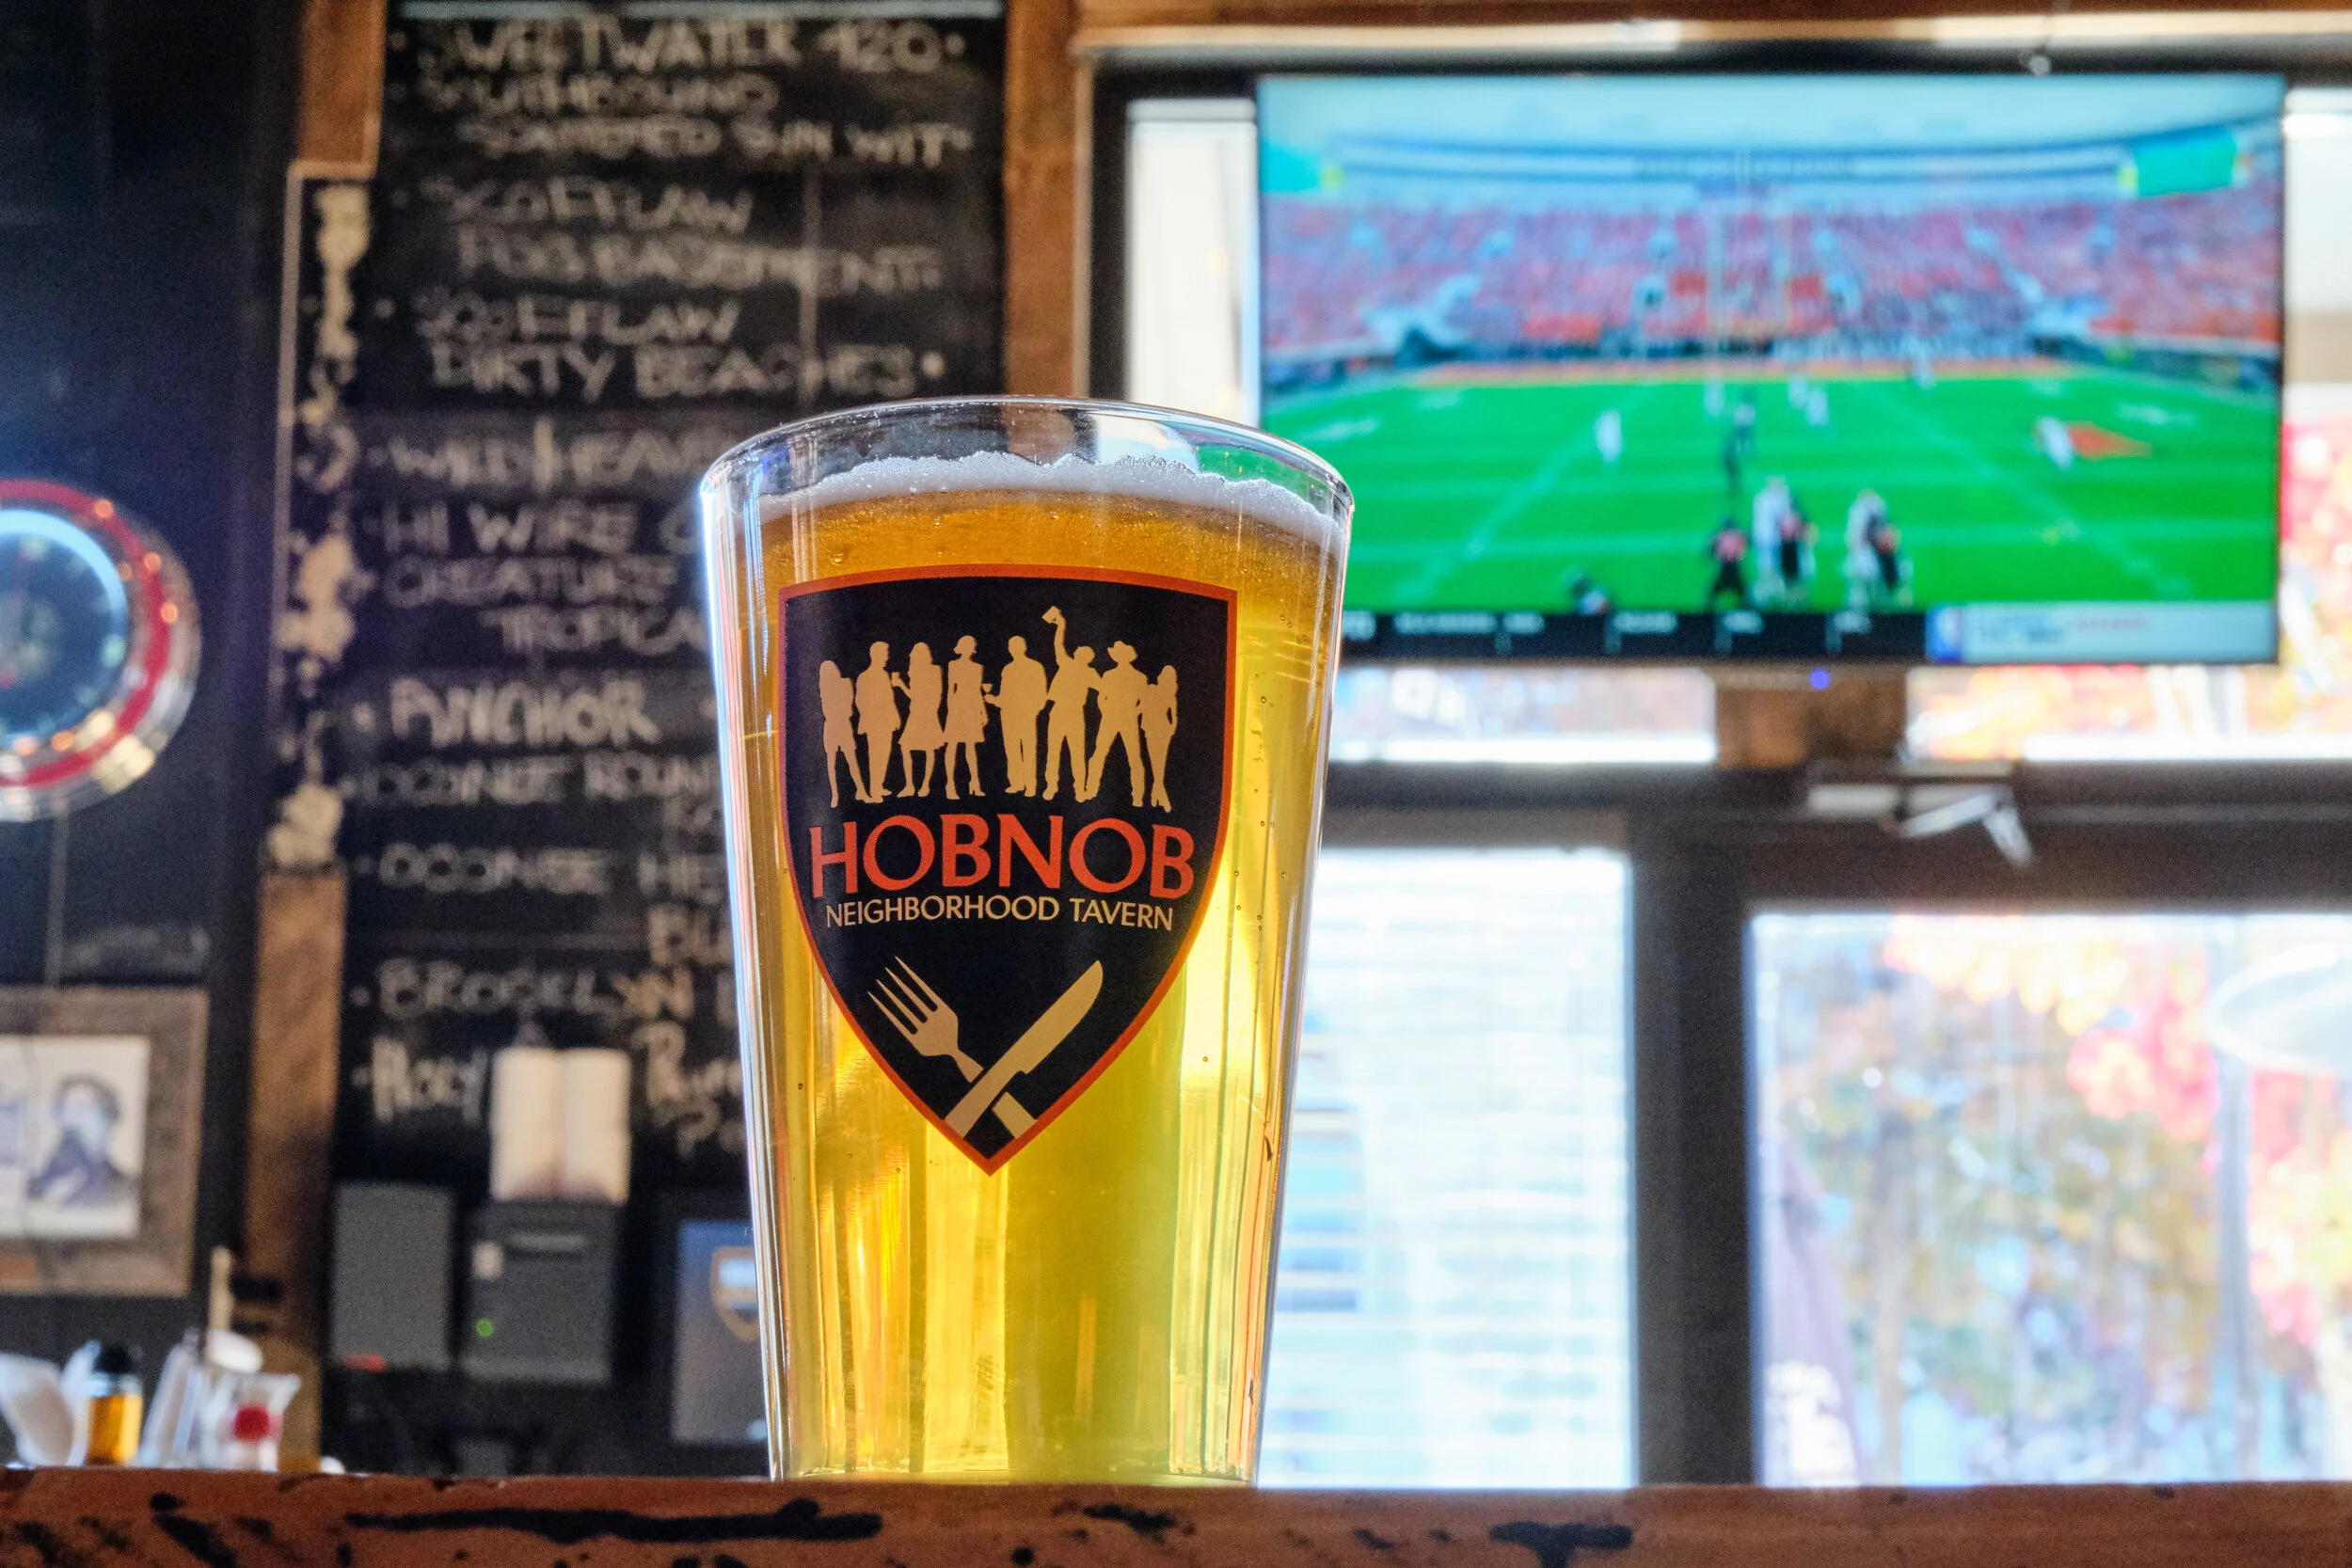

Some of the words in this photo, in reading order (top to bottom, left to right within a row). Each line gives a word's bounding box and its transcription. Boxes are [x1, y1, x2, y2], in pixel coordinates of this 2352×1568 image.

[809, 814, 1195, 899] HOBNOB
[826, 895, 1059, 928] NEIGHBORHOOD
[1069, 897, 1174, 931] TAVERN
